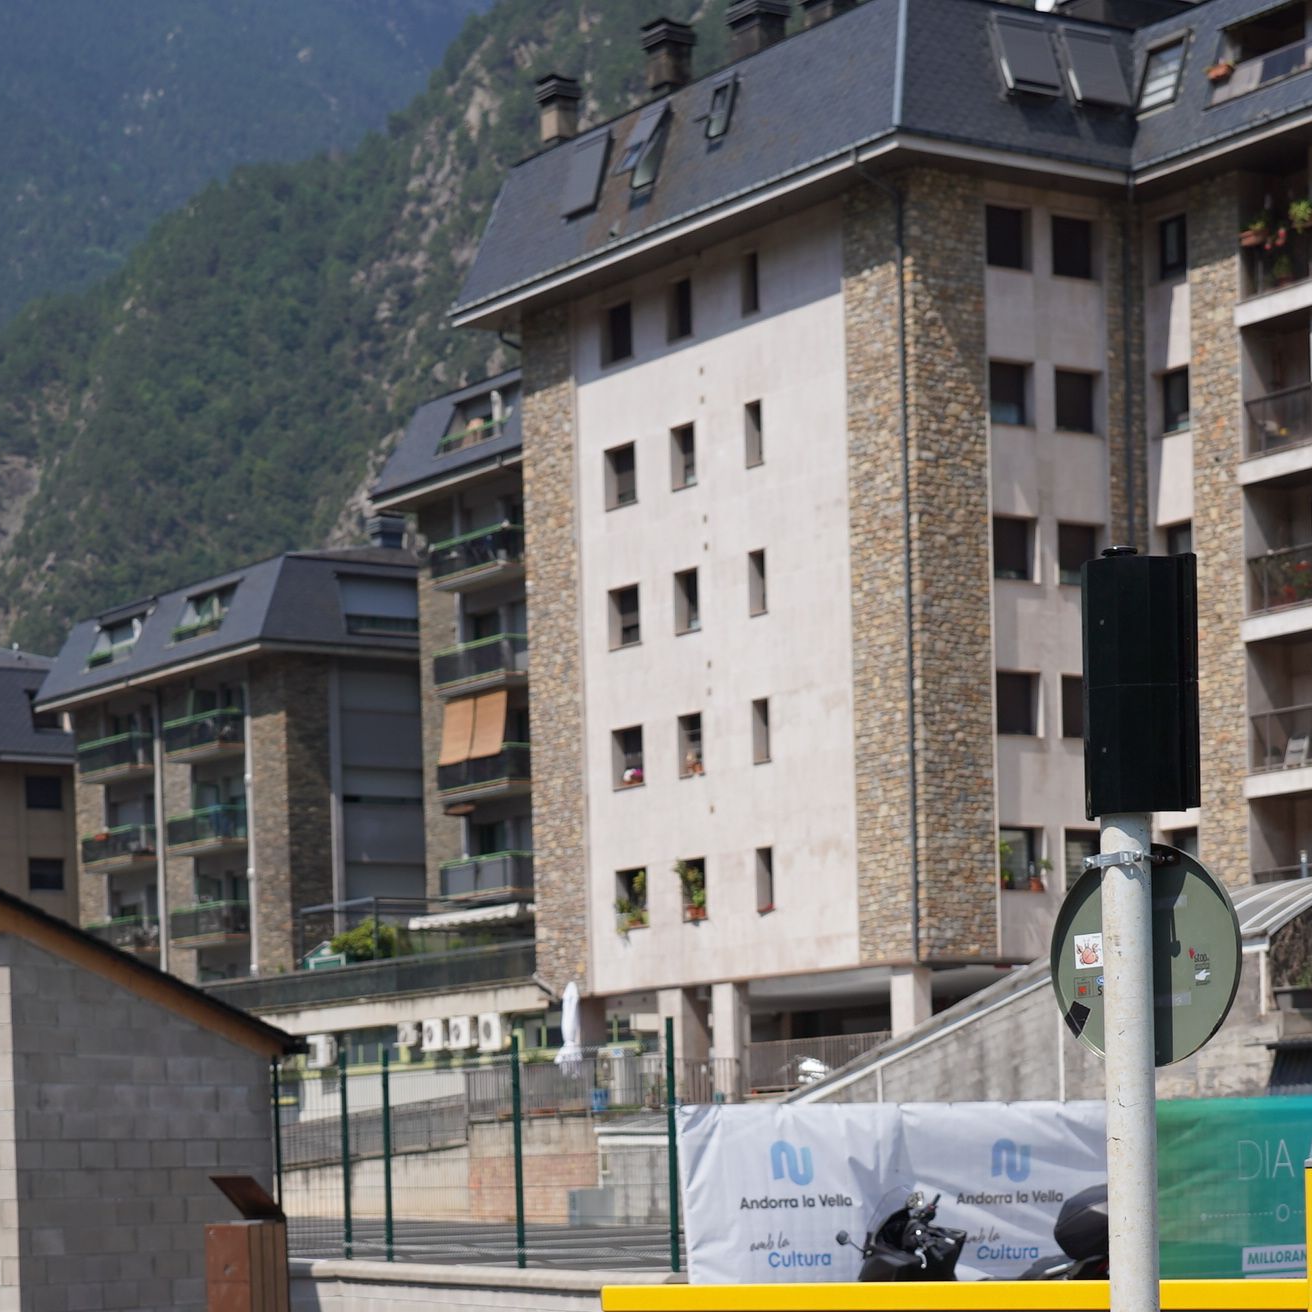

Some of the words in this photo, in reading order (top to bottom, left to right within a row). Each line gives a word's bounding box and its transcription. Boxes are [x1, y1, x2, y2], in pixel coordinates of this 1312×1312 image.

[1238, 1138, 1295, 1180] DIA
[740, 1196, 799, 1210] Andorra
[802, 1195, 816, 1208] la
[818, 1194, 853, 1208] Vella
[956, 1191, 1013, 1205] Andorra
[1016, 1190, 1029, 1204] la
[1031, 1189, 1064, 1203] Vella
[750, 1234, 775, 1251] amb
[778, 1231, 790, 1249] la
[768, 1251, 832, 1268] Cultura
[976, 1244, 1039, 1260] Cultura
